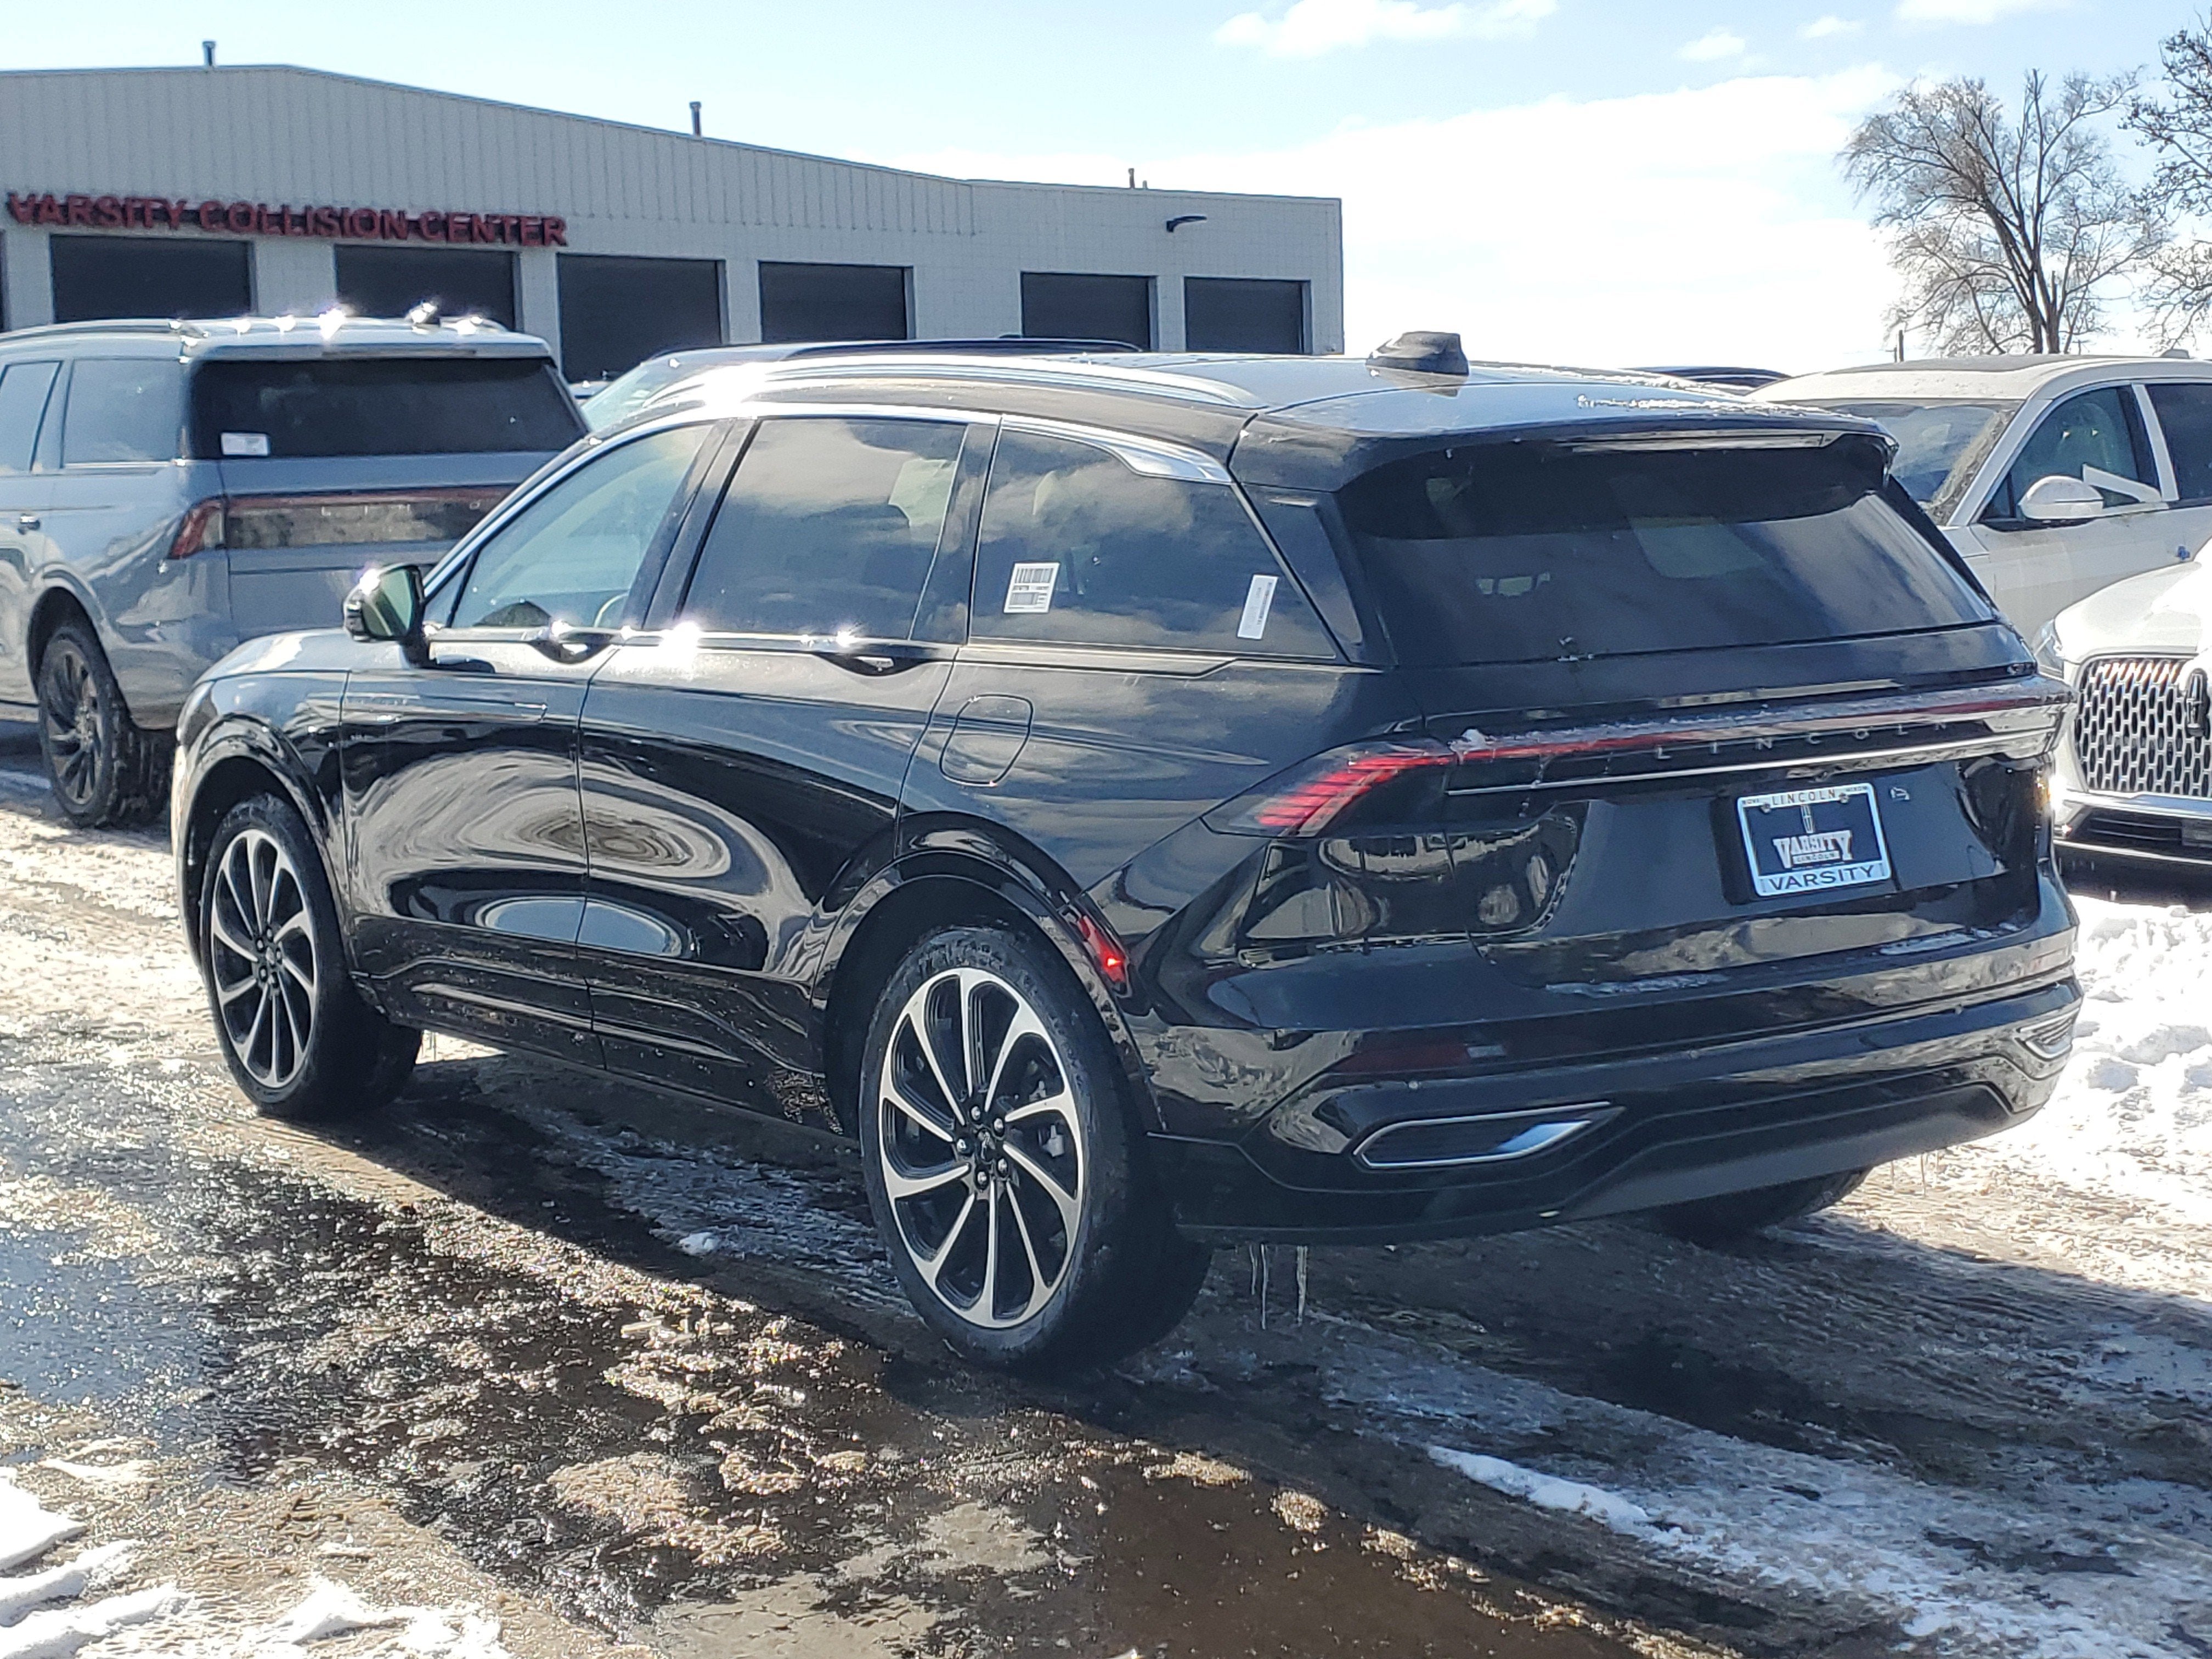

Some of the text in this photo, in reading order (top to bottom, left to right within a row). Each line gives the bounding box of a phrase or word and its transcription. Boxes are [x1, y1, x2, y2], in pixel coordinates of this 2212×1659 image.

[7, 191, 568, 247] VARSITY COLLISION CENTER
[1655, 721, 1948, 760] LINCOLN
[1771, 789, 1836, 805] LINCOLN
[1773, 830, 1853, 868] VARSITY
[1797, 853, 1835, 862] LINCOLN
[1769, 864, 1874, 891] VARSITY
